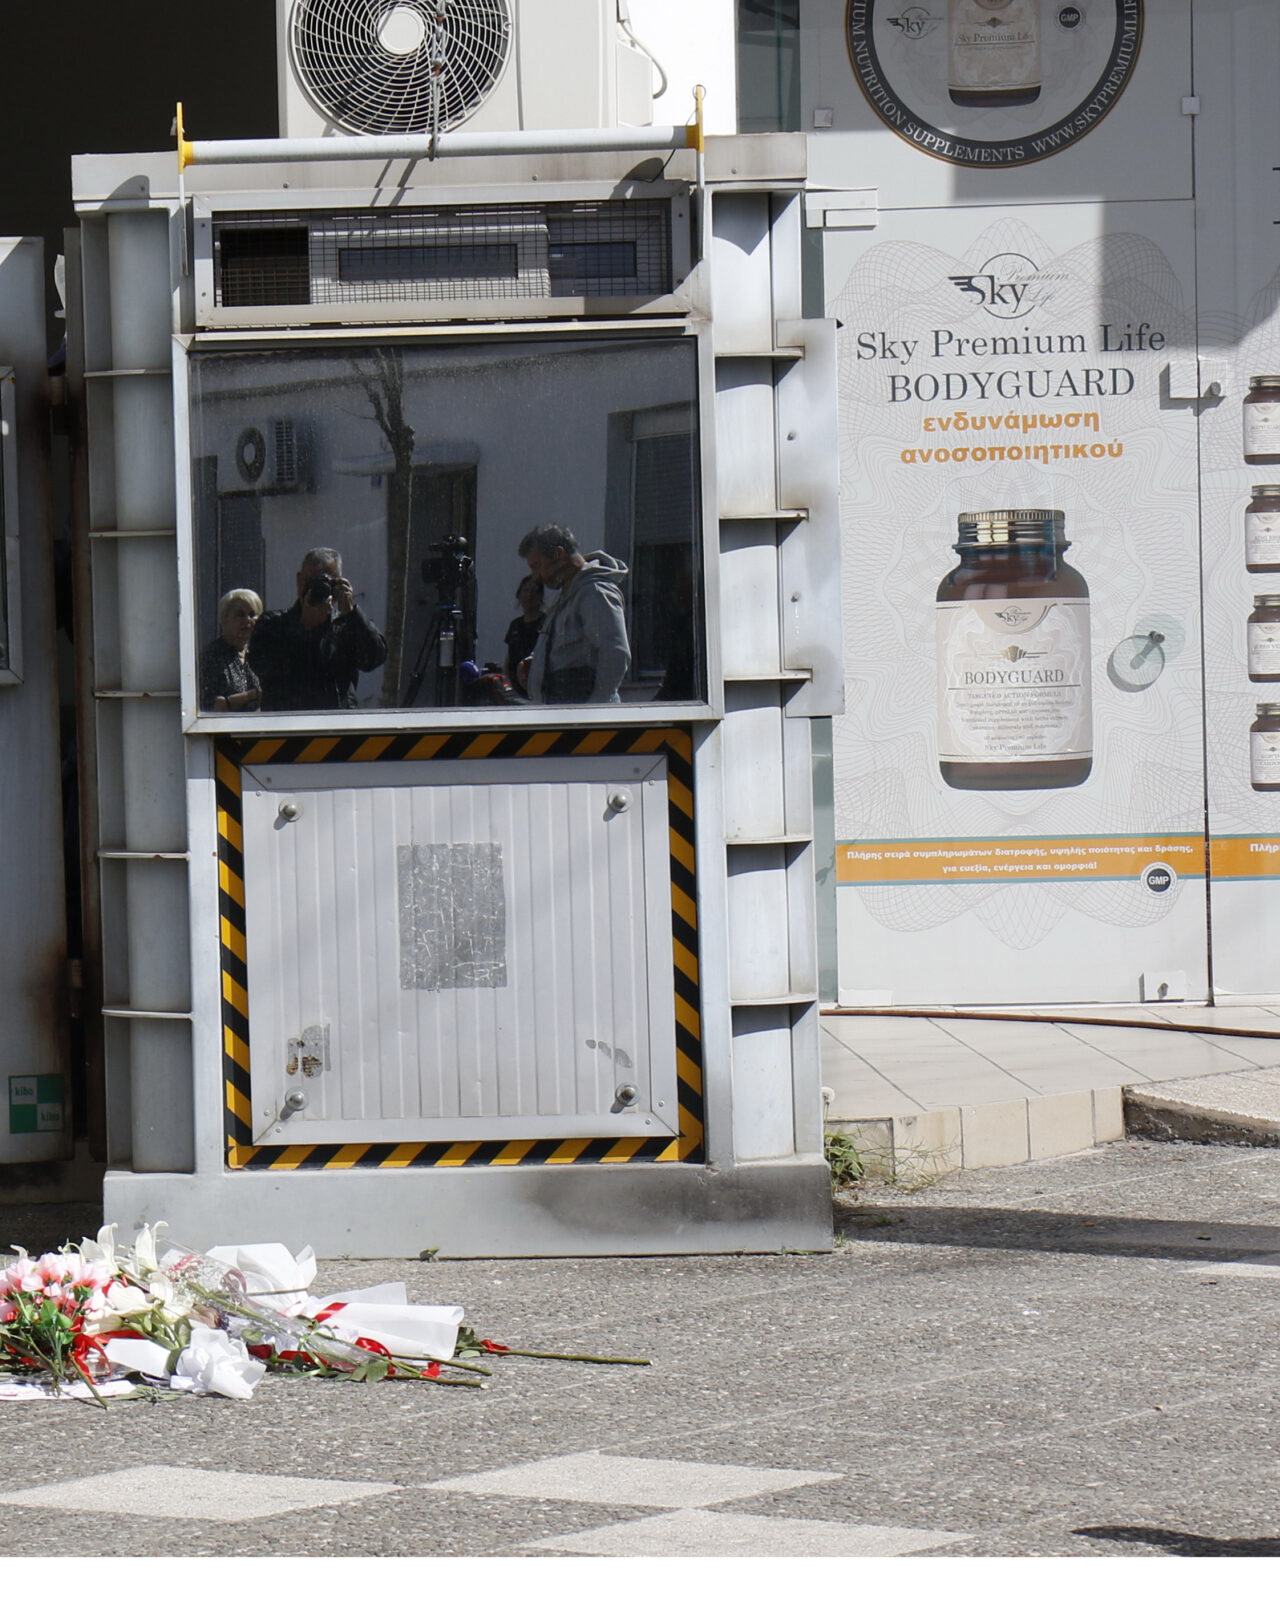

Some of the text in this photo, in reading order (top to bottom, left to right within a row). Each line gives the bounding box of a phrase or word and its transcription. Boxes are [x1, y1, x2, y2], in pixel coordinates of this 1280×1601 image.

[886, 17, 926, 36] Sky
[1060, 12, 1079, 21] GMP
[853, 40, 906, 126] NUTRITION
[903, 121, 1025, 162] SUPPLEMENTS
[947, 274, 1029, 313] Sky
[856, 322, 1166, 366] Sky Premium Life
[887, 366, 1135, 403] BODYGUARD
[922, 409, 1100, 434] ενδυνάμωση
[900, 437, 1124, 465] ανοσοποιητικού
[964, 669, 1065, 686] BODYGUARD
[847, 851, 882, 860] Πλήρης
[884, 850, 910, 860] σειρά
[913, 848, 992, 859] συμπληρωμάτων
[995, 847, 1048, 857] διατροφής,
[1049, 846, 1086, 856] υψηλής
[1088, 846, 1136, 854] ποιότητας
[942, 865, 957, 874] για
[993, 863, 1034, 872] ενέργεια
[1053, 861, 1097, 871] ομορφιά!
[1148, 875, 1169, 886] GMP
